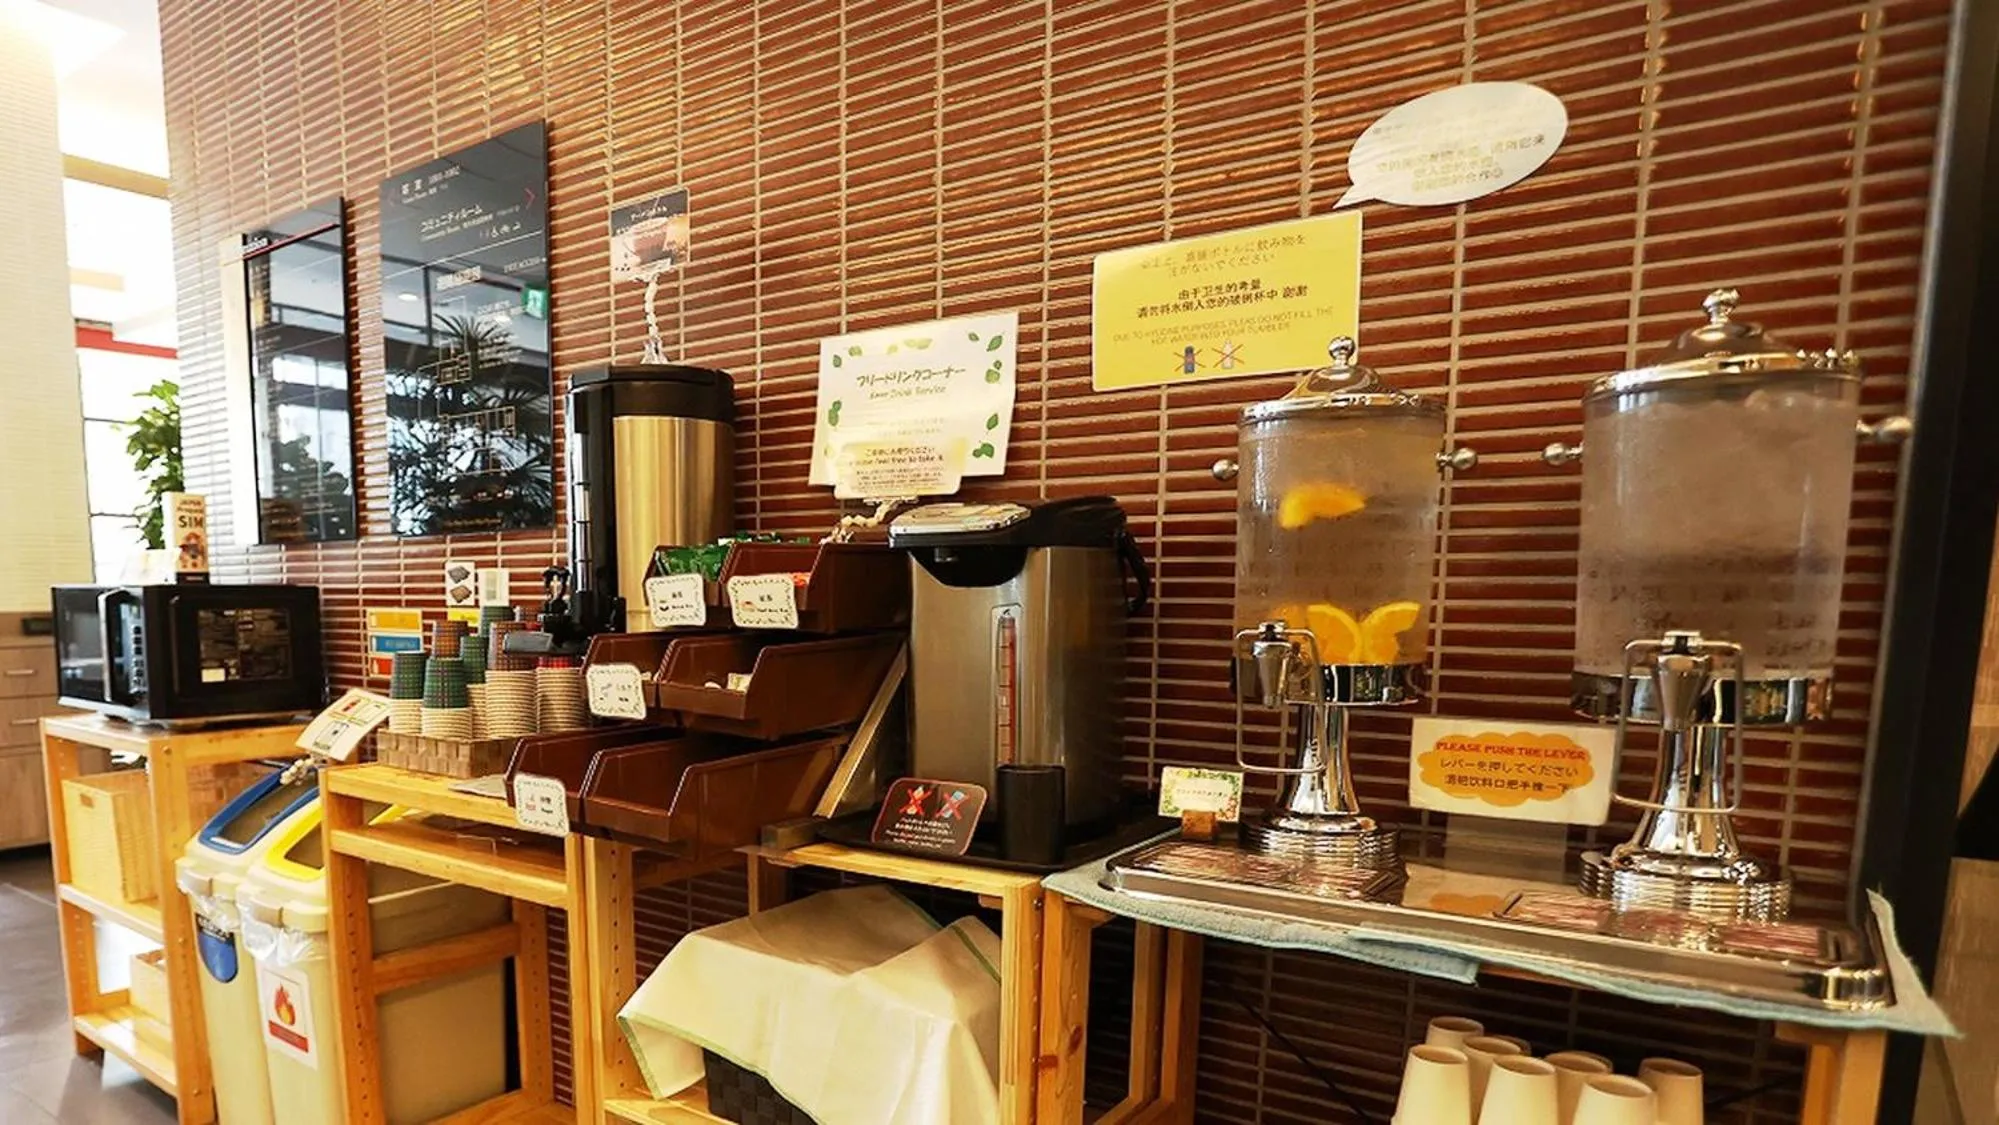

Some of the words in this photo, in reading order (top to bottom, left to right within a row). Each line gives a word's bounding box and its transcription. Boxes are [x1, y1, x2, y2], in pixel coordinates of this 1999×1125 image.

[856, 365, 966, 387] フリードリンクコーナー
[178, 515, 204, 529] SIM
[1436, 741, 1482, 753] PLEASE
[1485, 743, 1516, 755] PUSH
[1519, 746, 1543, 757] THE
[1544, 748, 1587, 761] LEVER
[1440, 758, 1579, 778] レバーを押してください
